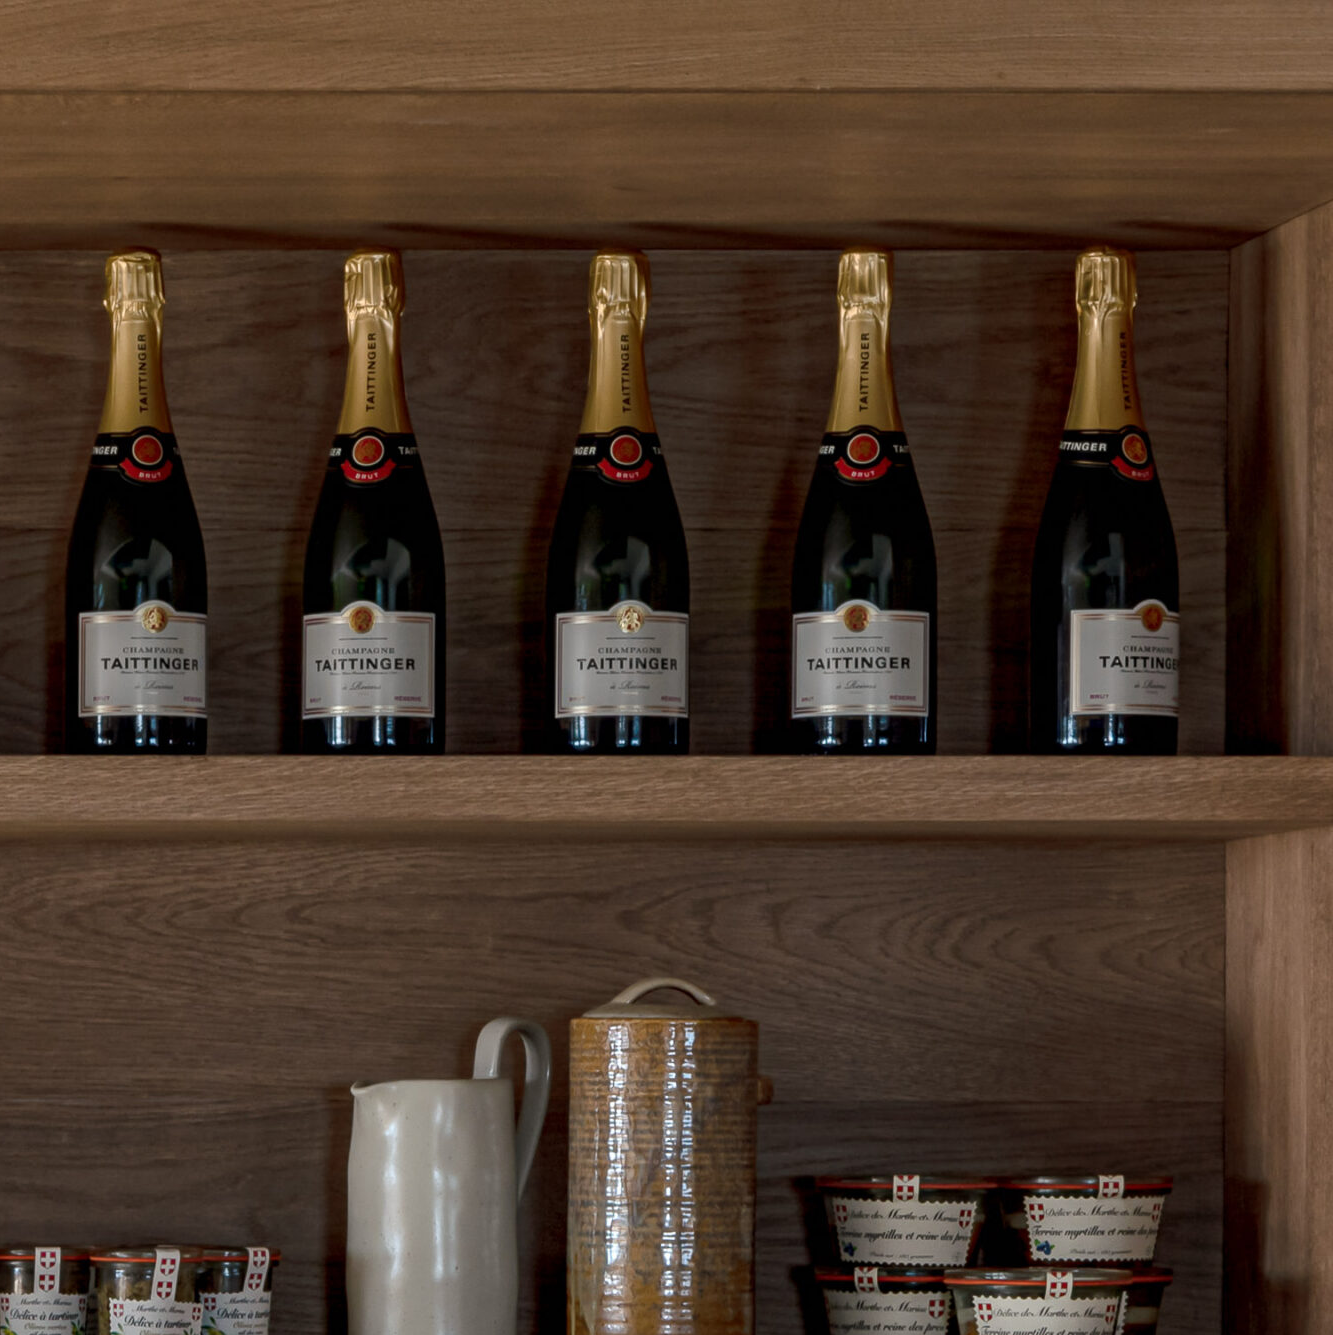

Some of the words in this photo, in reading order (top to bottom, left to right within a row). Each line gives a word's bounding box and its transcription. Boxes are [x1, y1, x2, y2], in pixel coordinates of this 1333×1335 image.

[137, 334, 149, 413] TAITTINGER
[365, 332, 377, 412] TAITTINGER
[621, 334, 630, 414] TAITTINGER
[859, 332, 870, 412] TAITTINGER
[1119, 332, 1132, 410] TAITTINGER
[138, 471, 161, 479] BRUT
[355, 472, 379, 480] BRUT
[615, 471, 640, 479] BRUT
[851, 470, 876, 478] BRUT
[101, 658, 198, 671] TAITTINGER
[315, 658, 416, 672] TAITTINGER
[576, 657, 678, 671] TAITTINGER
[807, 657, 910, 671] TAITTINGER
[1099, 656, 1177, 671] TAITTINGE
[1033, 1225, 1062, 1236] Terrine
[1064, 1225, 1105, 1240] myrtilles
[1107, 1228, 1116, 1236] et
